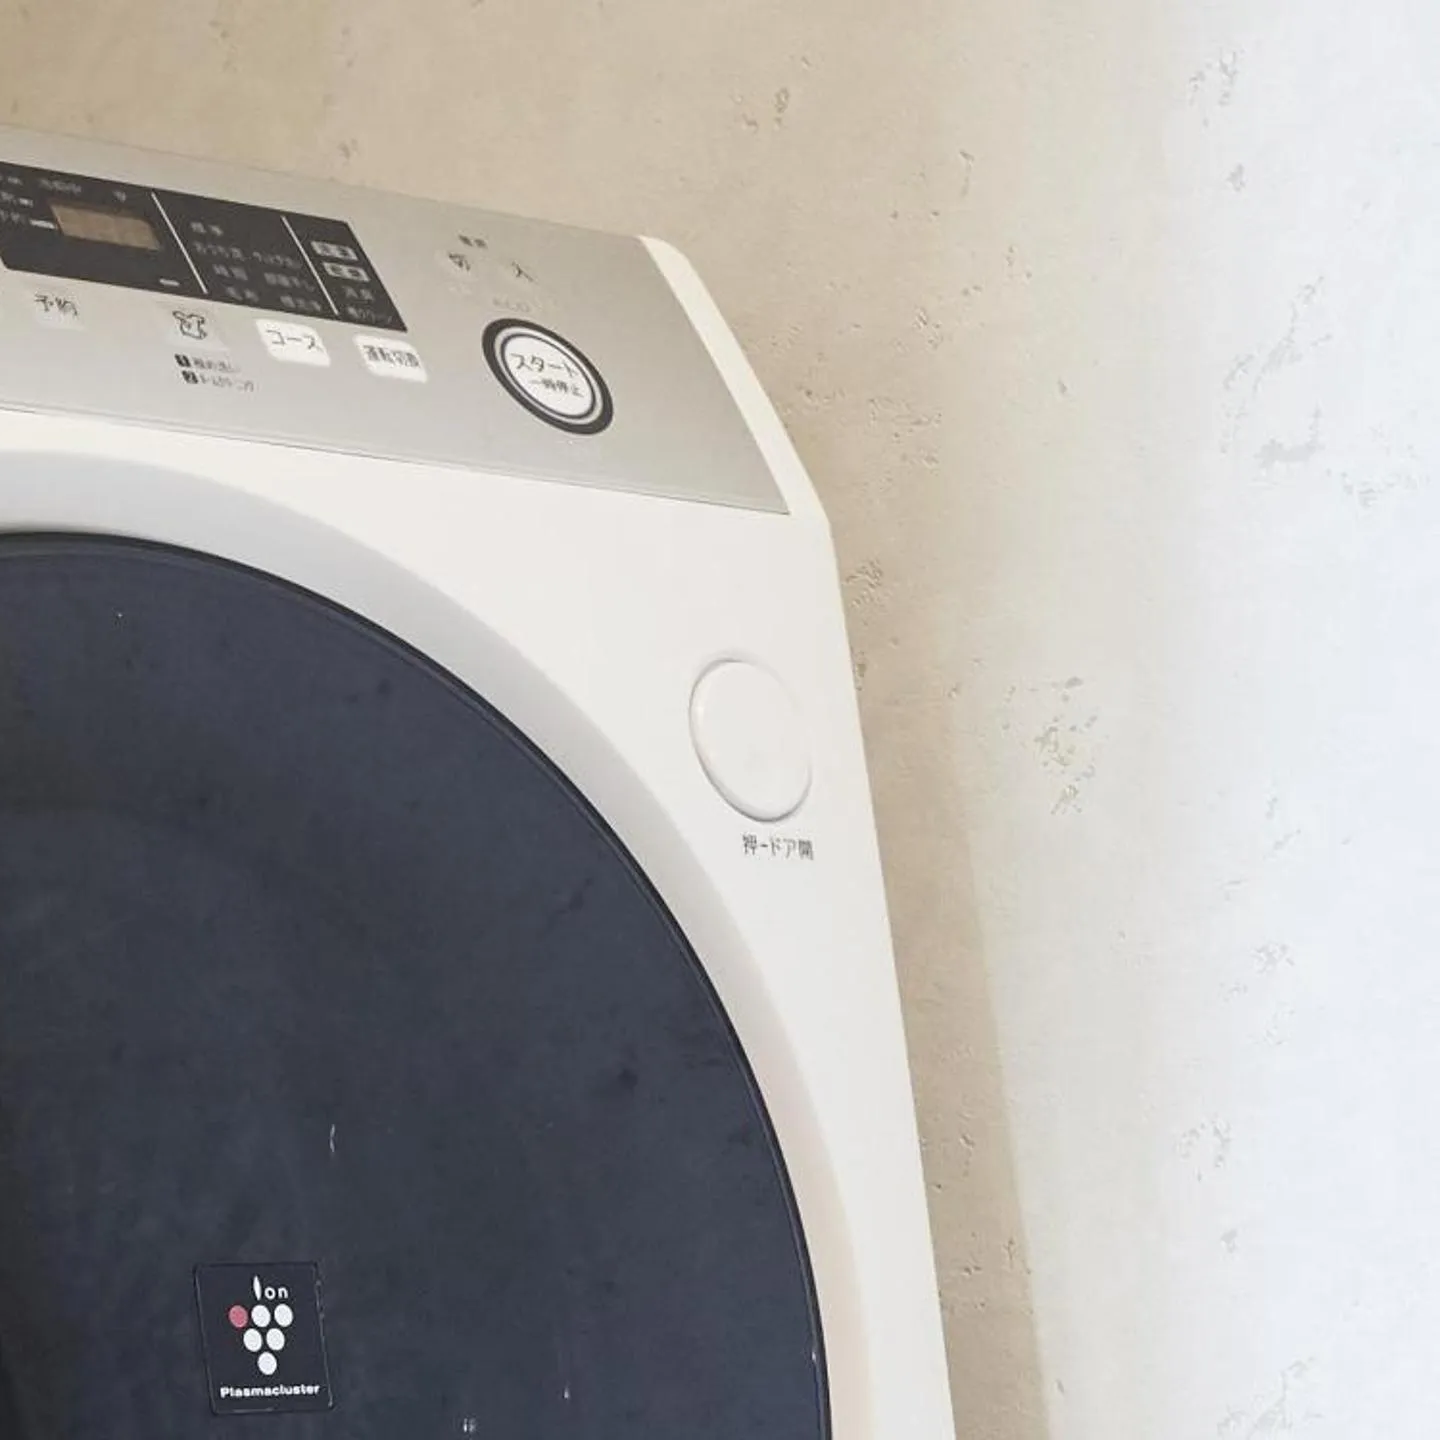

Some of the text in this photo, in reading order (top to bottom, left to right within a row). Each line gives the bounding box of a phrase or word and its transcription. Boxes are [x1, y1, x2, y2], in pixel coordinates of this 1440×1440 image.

[266, 329, 324, 352] コース
[511, 353, 579, 378] スタート
[253, 1275, 289, 1300] Ion
[220, 1384, 320, 1399] Plasmacluster
